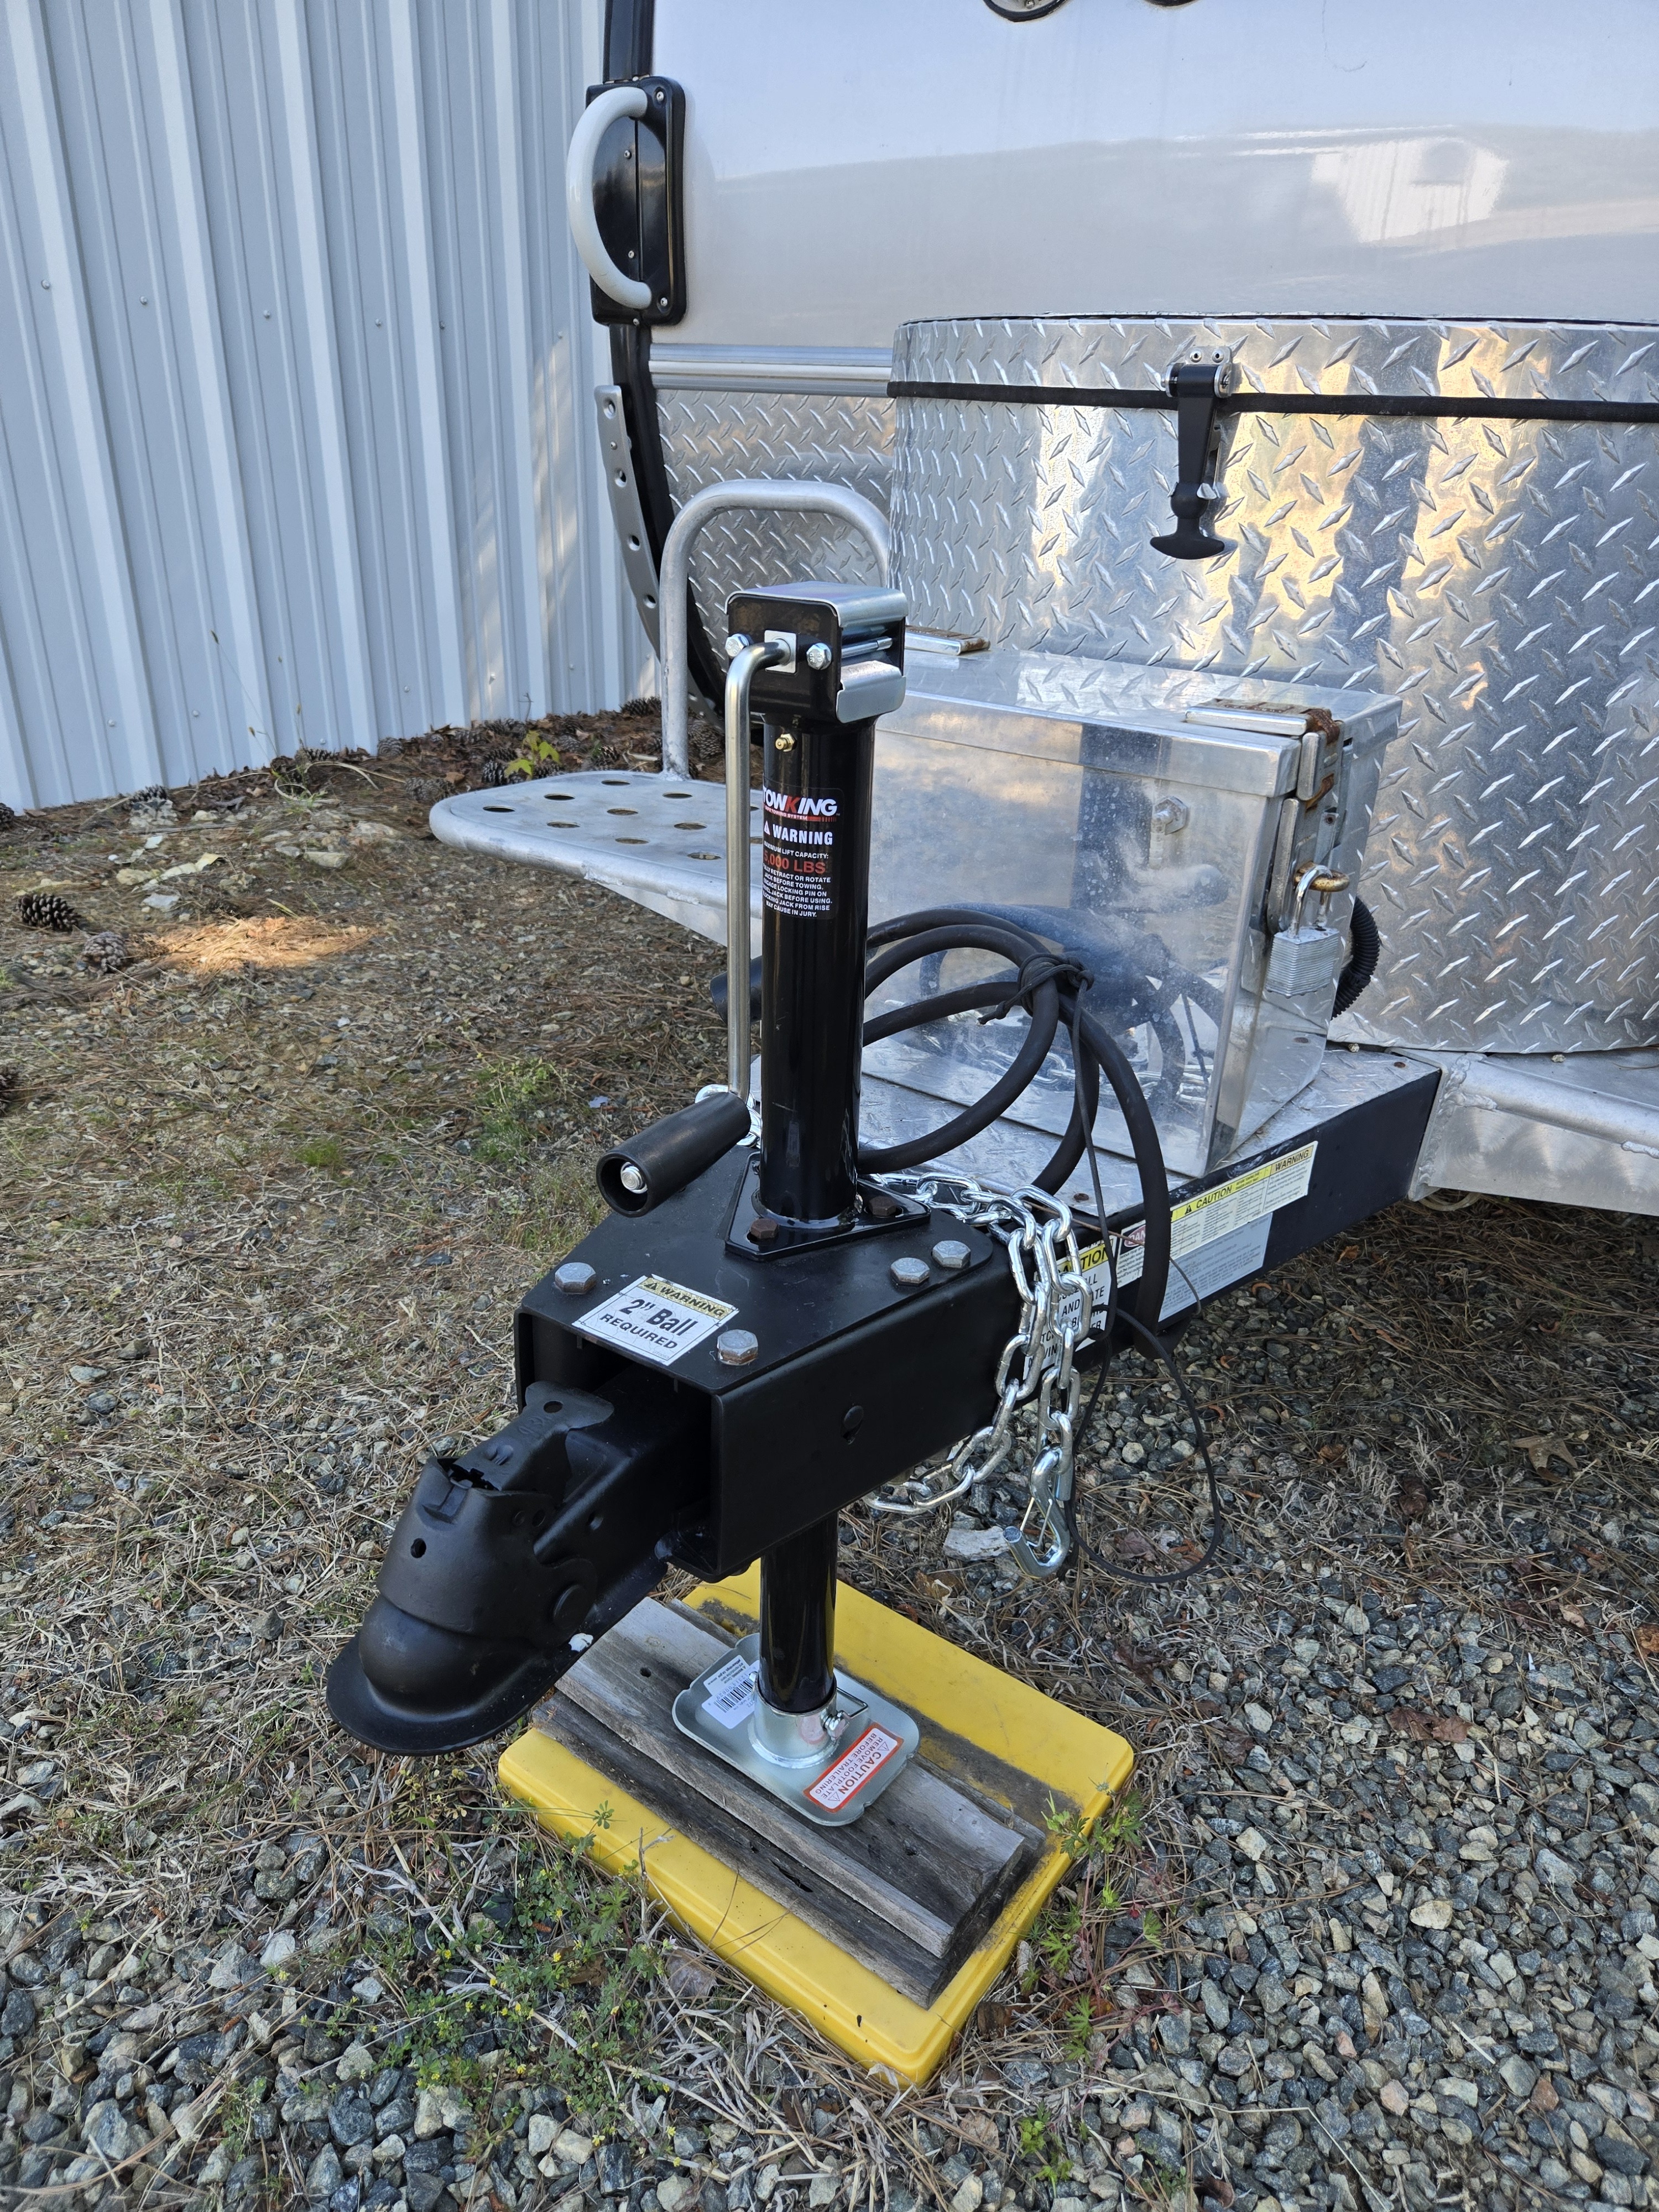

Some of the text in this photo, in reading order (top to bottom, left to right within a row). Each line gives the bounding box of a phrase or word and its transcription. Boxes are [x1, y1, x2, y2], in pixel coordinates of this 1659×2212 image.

[763, 786, 837, 816] TOWKING
[773, 824, 833, 845] WARNING
[764, 849, 826, 874] 5,000 LBS
[770, 868, 794, 880] RETRACT
[773, 877, 794, 887] BEFORE
[771, 890, 784, 899] JACK
[784, 895, 809, 903] BEFORE
[778, 885, 803, 895] LOCKING
[774, 904, 791, 914] CAUSE
[779, 900, 794, 908] JACK
[1275, 1150, 1309, 1171] WARNING
[1196, 1185, 1232, 1208] CAUTION
[660, 1286, 726, 1317] WARNING
[1062, 1298, 1080, 1317] AND
[599, 1313, 678, 1349] REQUIRED
[646, 1308, 698, 1336] Ball
[815, 1733, 877, 1794] BEFORE TRAILERING
[821, 1737, 883, 1798] REMOVE FOOTPLATE
[838, 1751, 881, 1794] CAUTION
